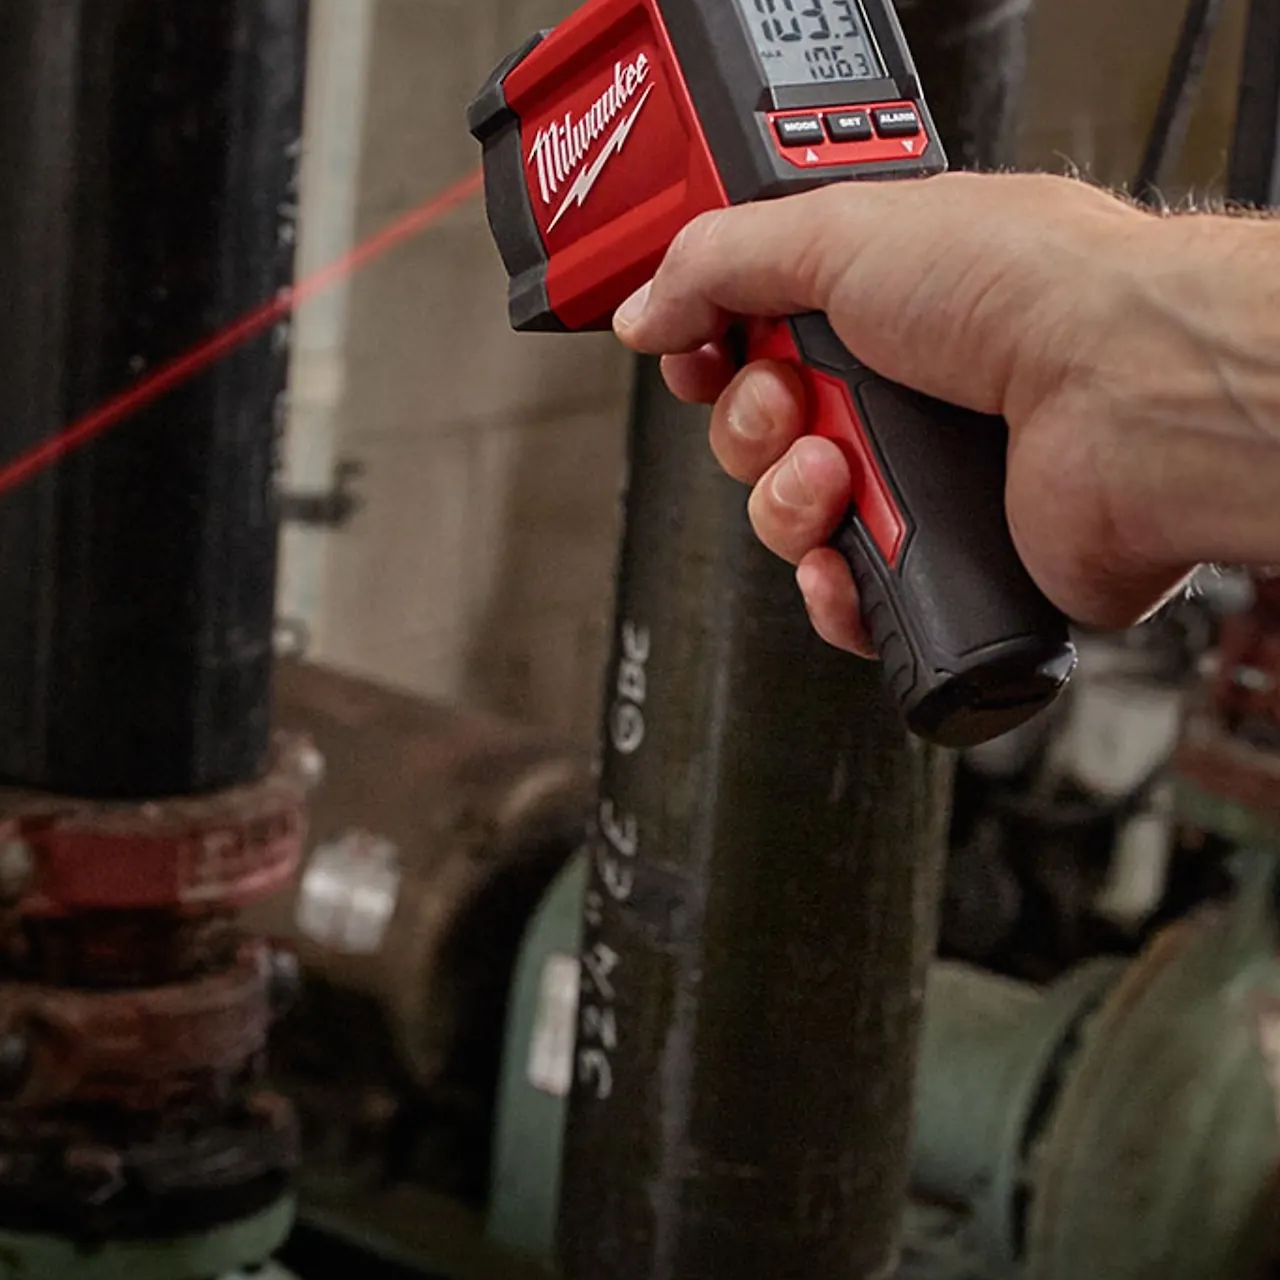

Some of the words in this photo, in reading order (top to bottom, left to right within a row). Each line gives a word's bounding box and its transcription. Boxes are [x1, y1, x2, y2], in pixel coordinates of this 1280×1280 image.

[528, 53, 649, 204] Milwaukee
[783, 120, 818, 132] MODE
[838, 116, 862, 128] SET
[879, 112, 916, 123] ALARM
